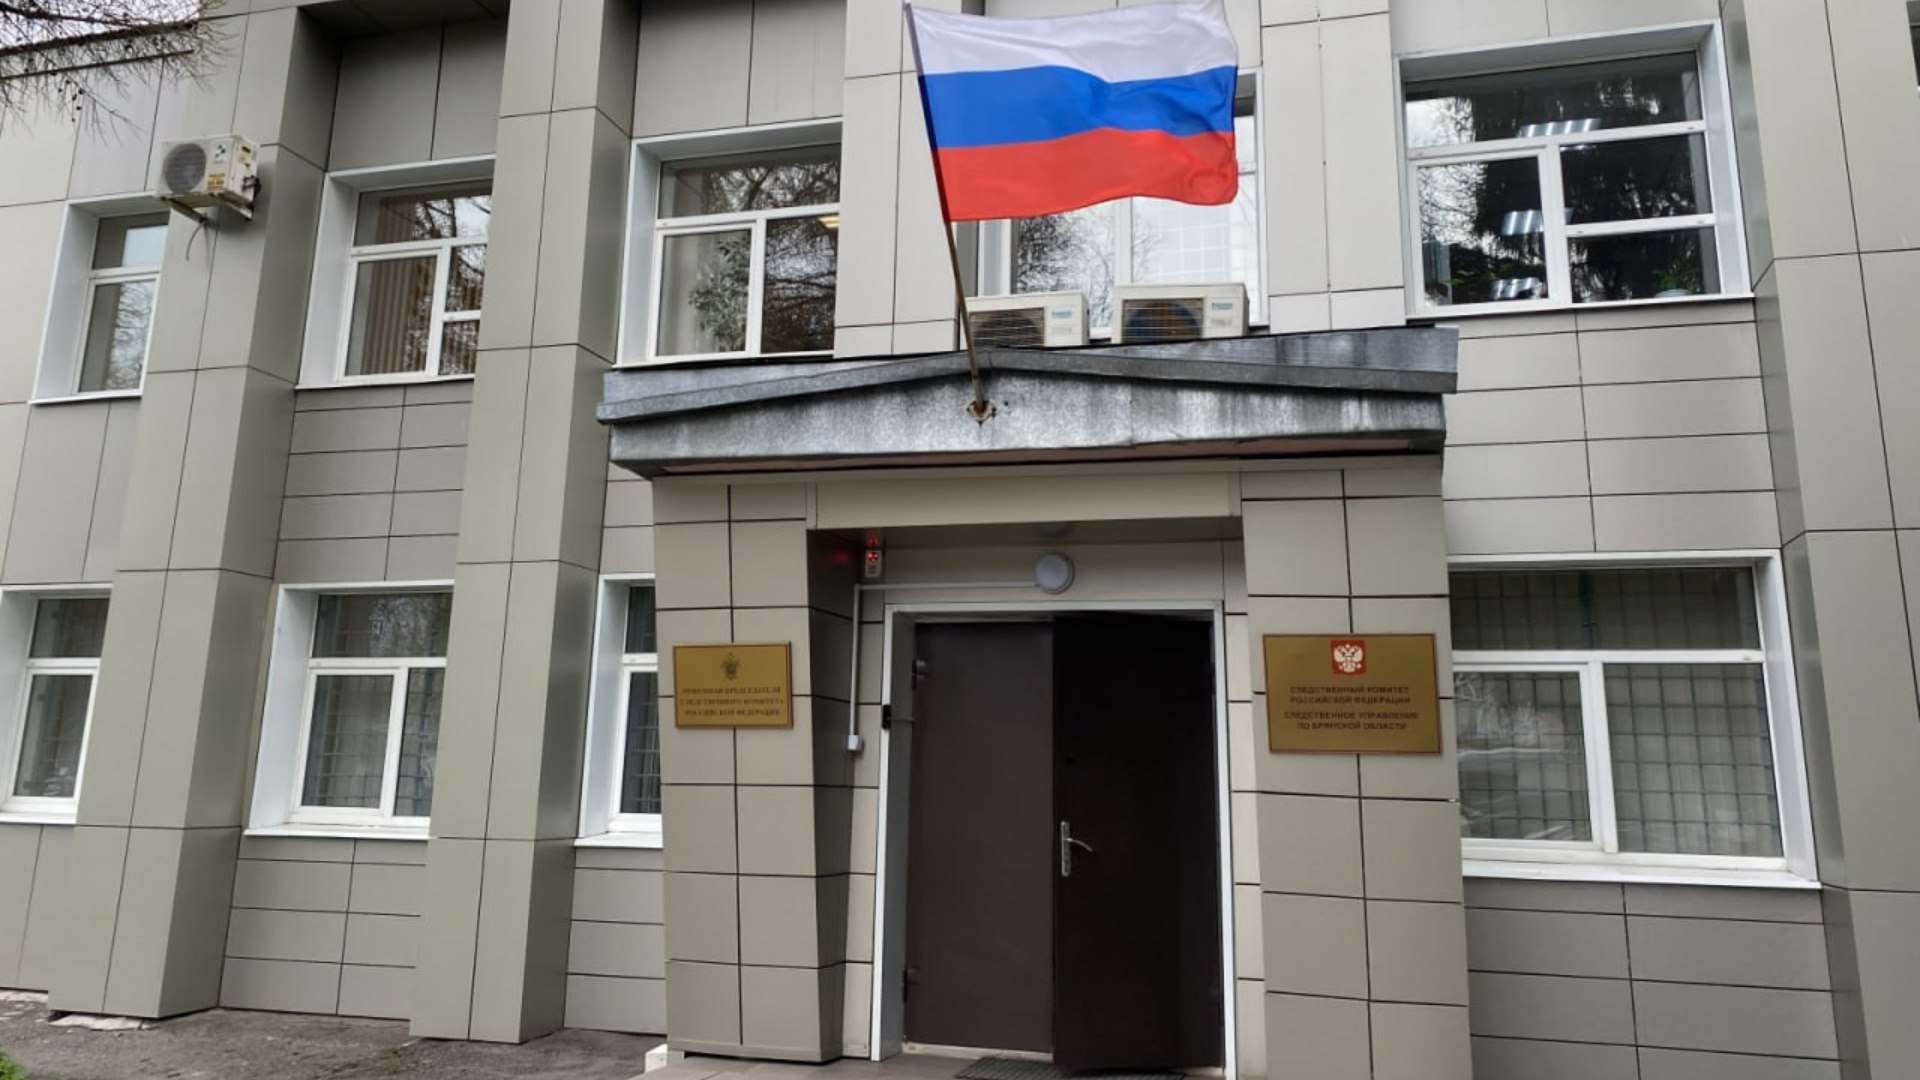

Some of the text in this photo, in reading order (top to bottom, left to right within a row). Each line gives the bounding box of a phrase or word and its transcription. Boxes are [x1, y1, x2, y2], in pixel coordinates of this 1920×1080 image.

[1290, 686, 1410, 694] СЛЕДСТВЕННЫЙ КОМИТЕТ
[1290, 696, 1411, 705] РОССИЙСКОЙ ФЕДЕРАЦИИ
[1284, 711, 1419, 719] СЛЕДСТВЕННОЕ УПРАВЛЕНИЕ
[1297, 721, 1407, 730] ПО БРЯНСКОЙ ОБЛАСТИ
